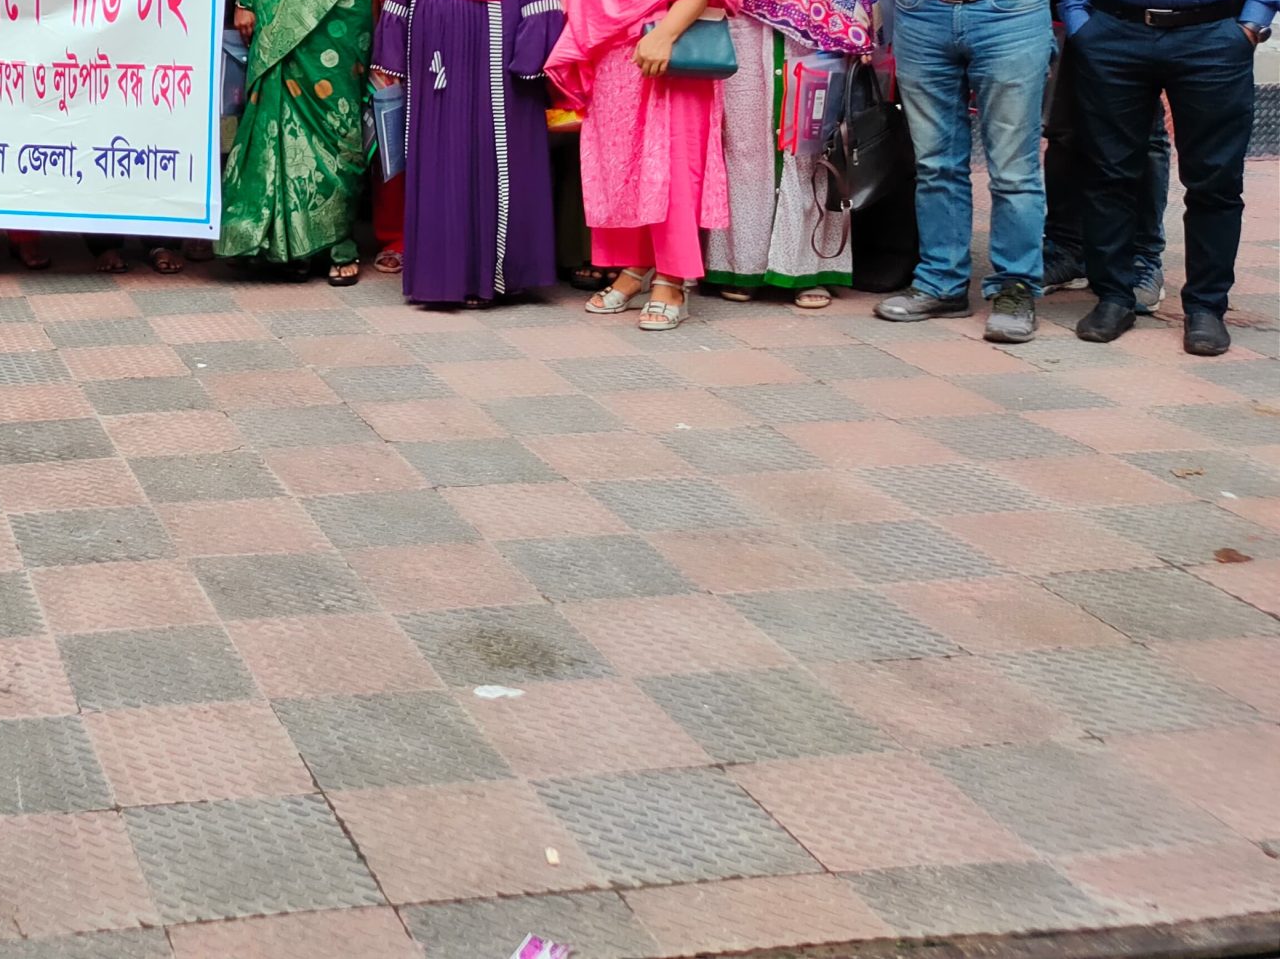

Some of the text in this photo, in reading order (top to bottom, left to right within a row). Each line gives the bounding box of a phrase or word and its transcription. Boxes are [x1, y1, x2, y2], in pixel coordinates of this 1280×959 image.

[31, 62, 47, 100] ও
[51, 46, 113, 116] লুটপাট
[116, 63, 147, 108] বন্ধ
[151, 59, 194, 114] হোক
[17, 139, 83, 185] জেলা,
[91, 135, 180, 184] বরিশাল
